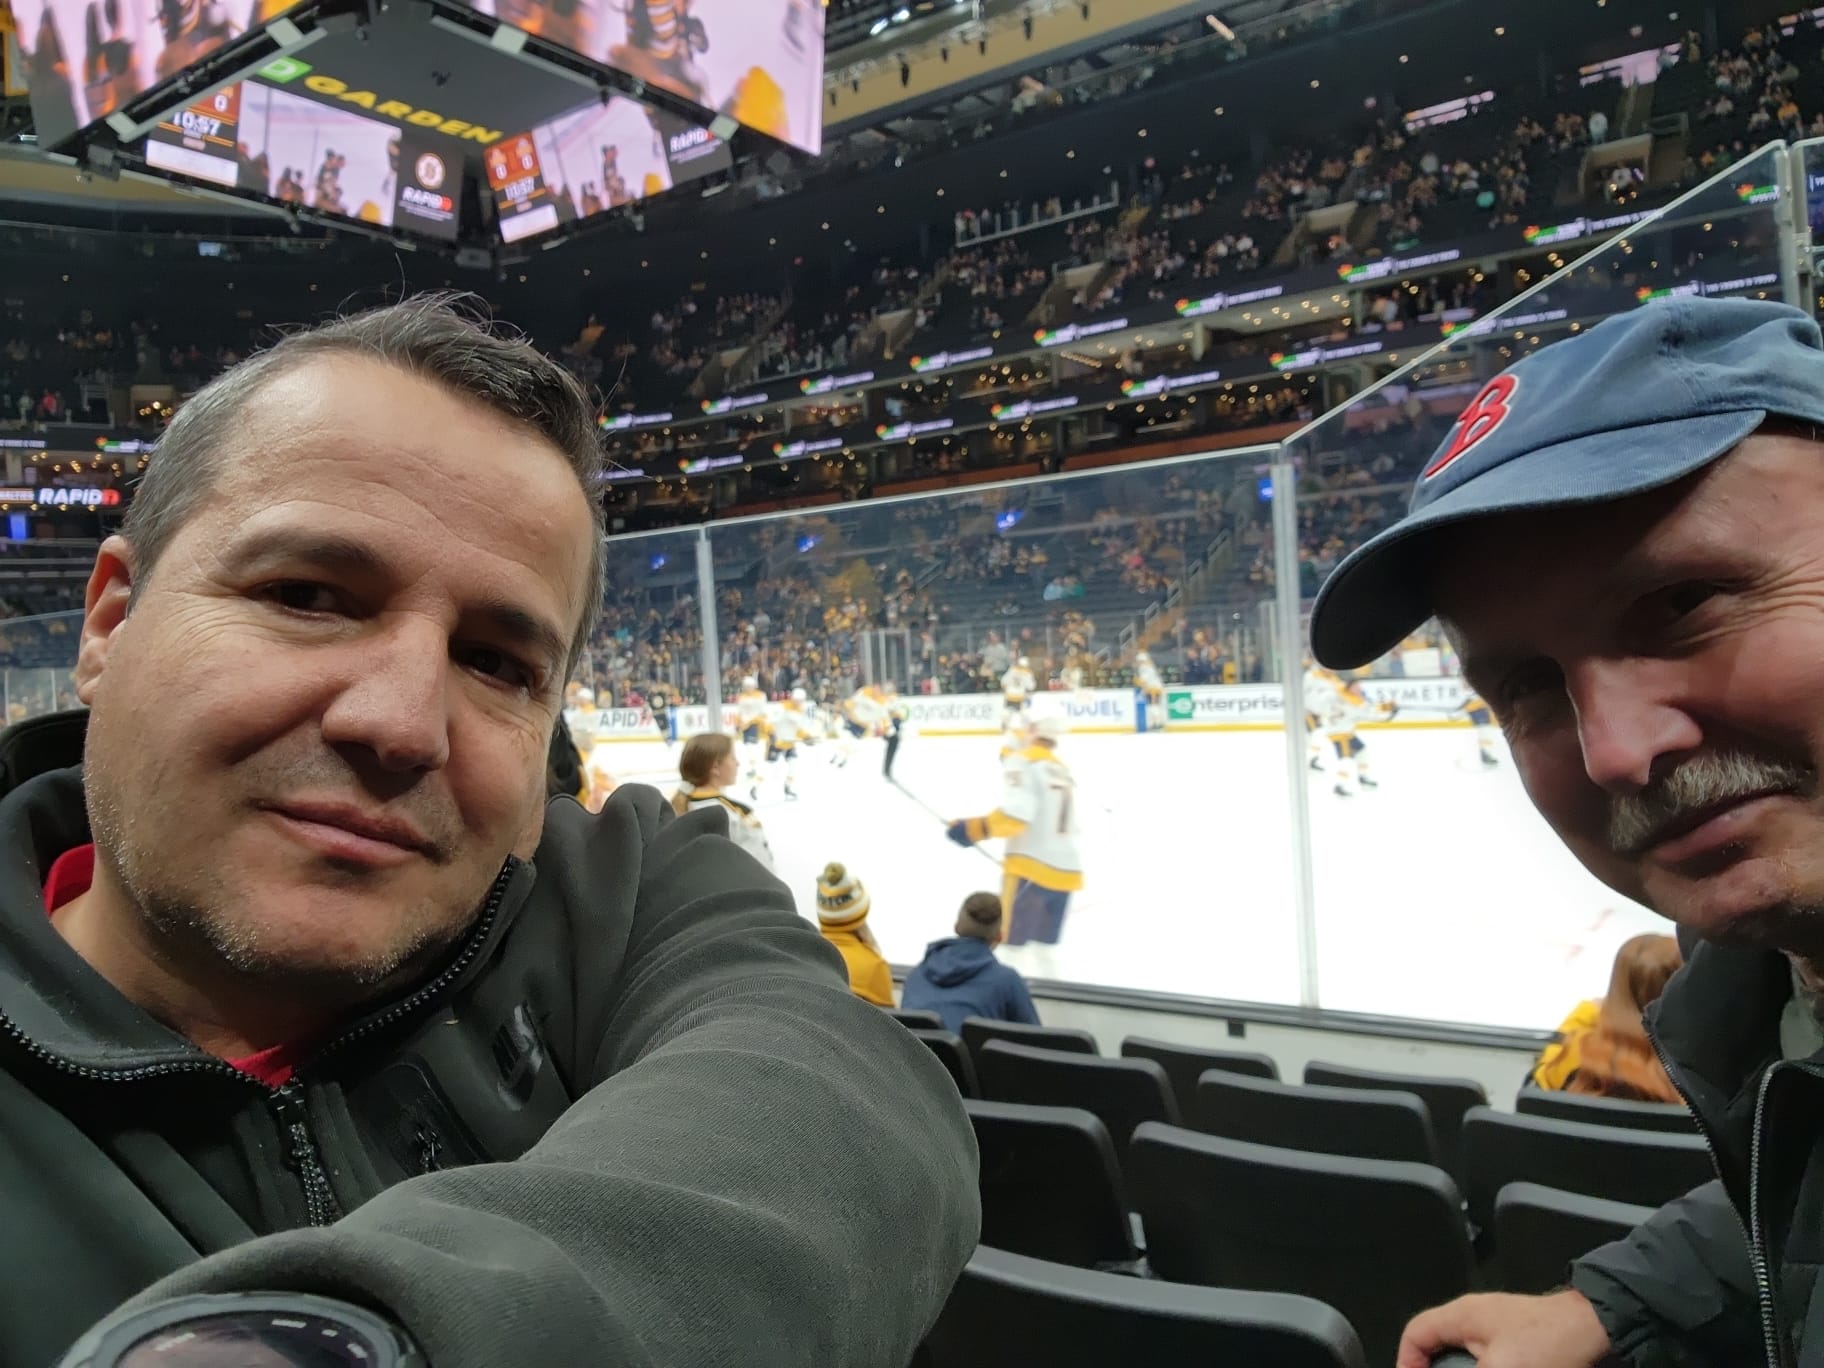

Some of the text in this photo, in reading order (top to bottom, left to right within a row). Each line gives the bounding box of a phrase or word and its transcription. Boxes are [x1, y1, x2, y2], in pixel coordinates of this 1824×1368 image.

[304, 75, 503, 143] GARDEN
[1424, 373, 1519, 481] B
[1168, 693, 1285, 713] enterpris
